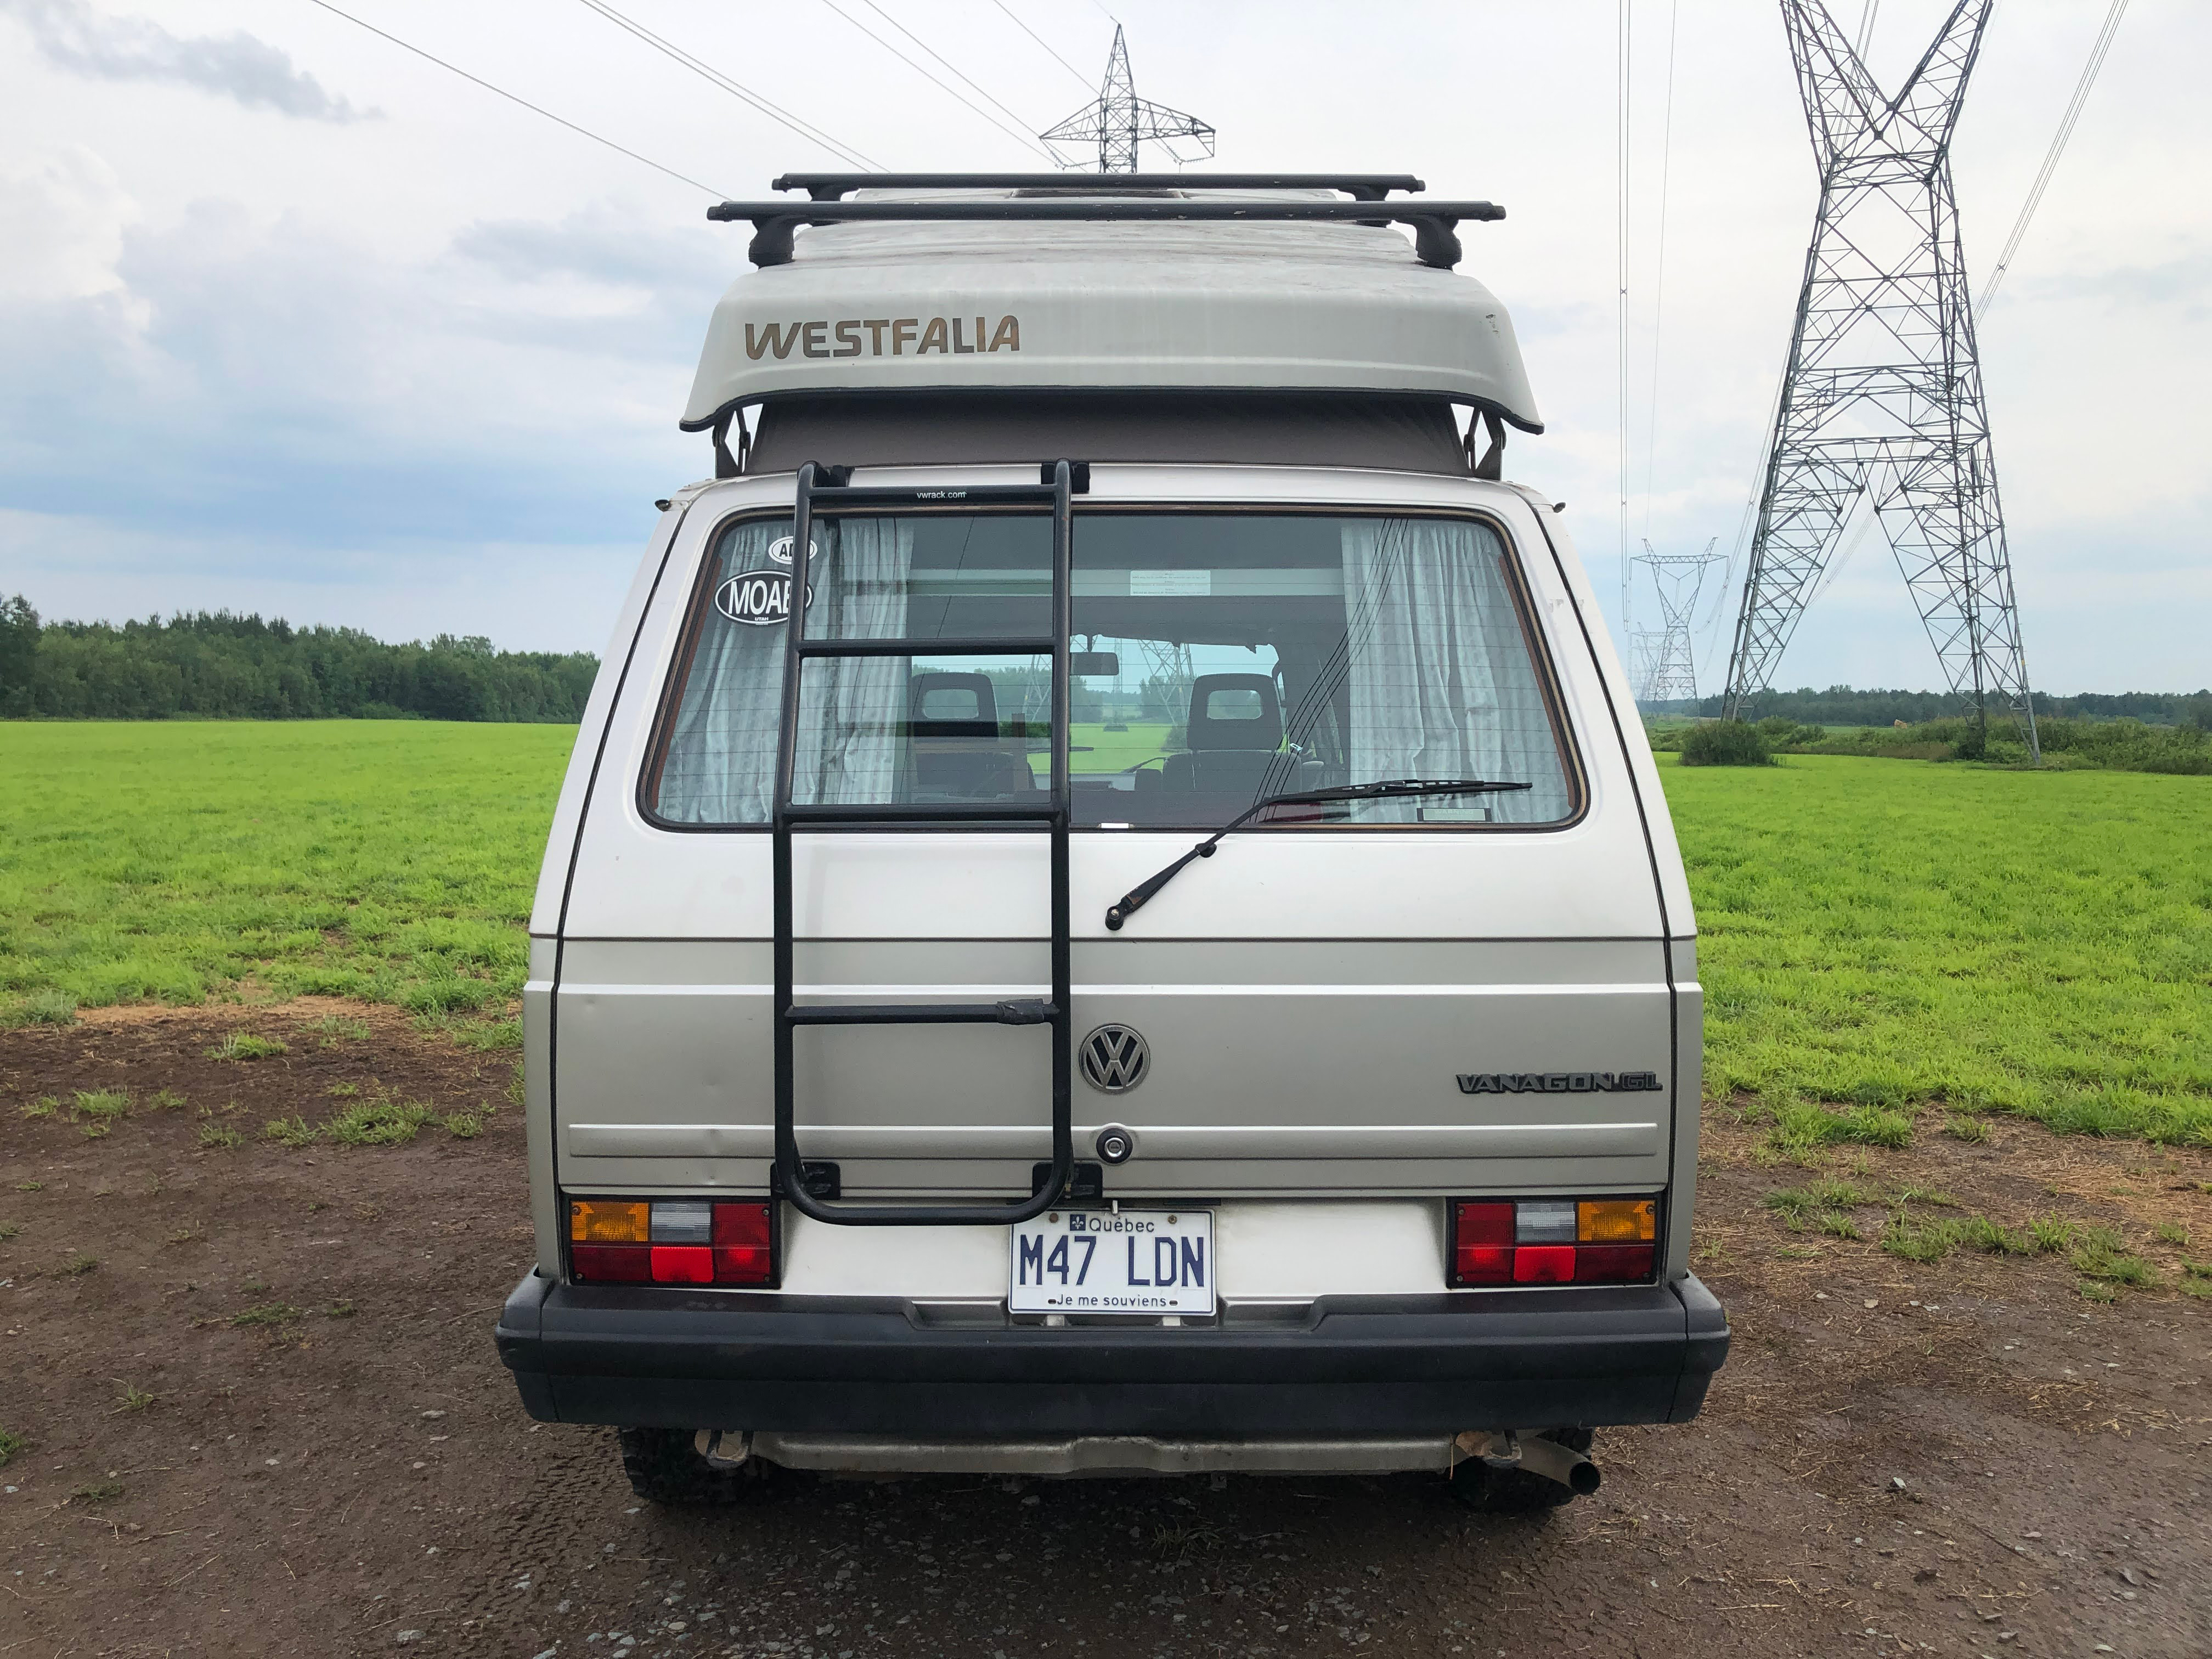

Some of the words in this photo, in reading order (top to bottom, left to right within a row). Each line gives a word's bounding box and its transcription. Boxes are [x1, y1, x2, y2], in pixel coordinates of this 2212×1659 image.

[745, 315, 1020, 360] WESTFALIA
[917, 490, 966, 499] vwrack.com
[1455, 1072, 1615, 1094] VANAGON
[1619, 1071, 1663, 1091] GL
[1089, 1216, 1155, 1232] Québec
[1019, 1234, 1097, 1285] M47
[1128, 1235, 1204, 1287] LDN
[1057, 1294, 1073, 1306] Je
[1079, 1297, 1098, 1306] me
[1103, 1294, 1167, 1307] souviens
